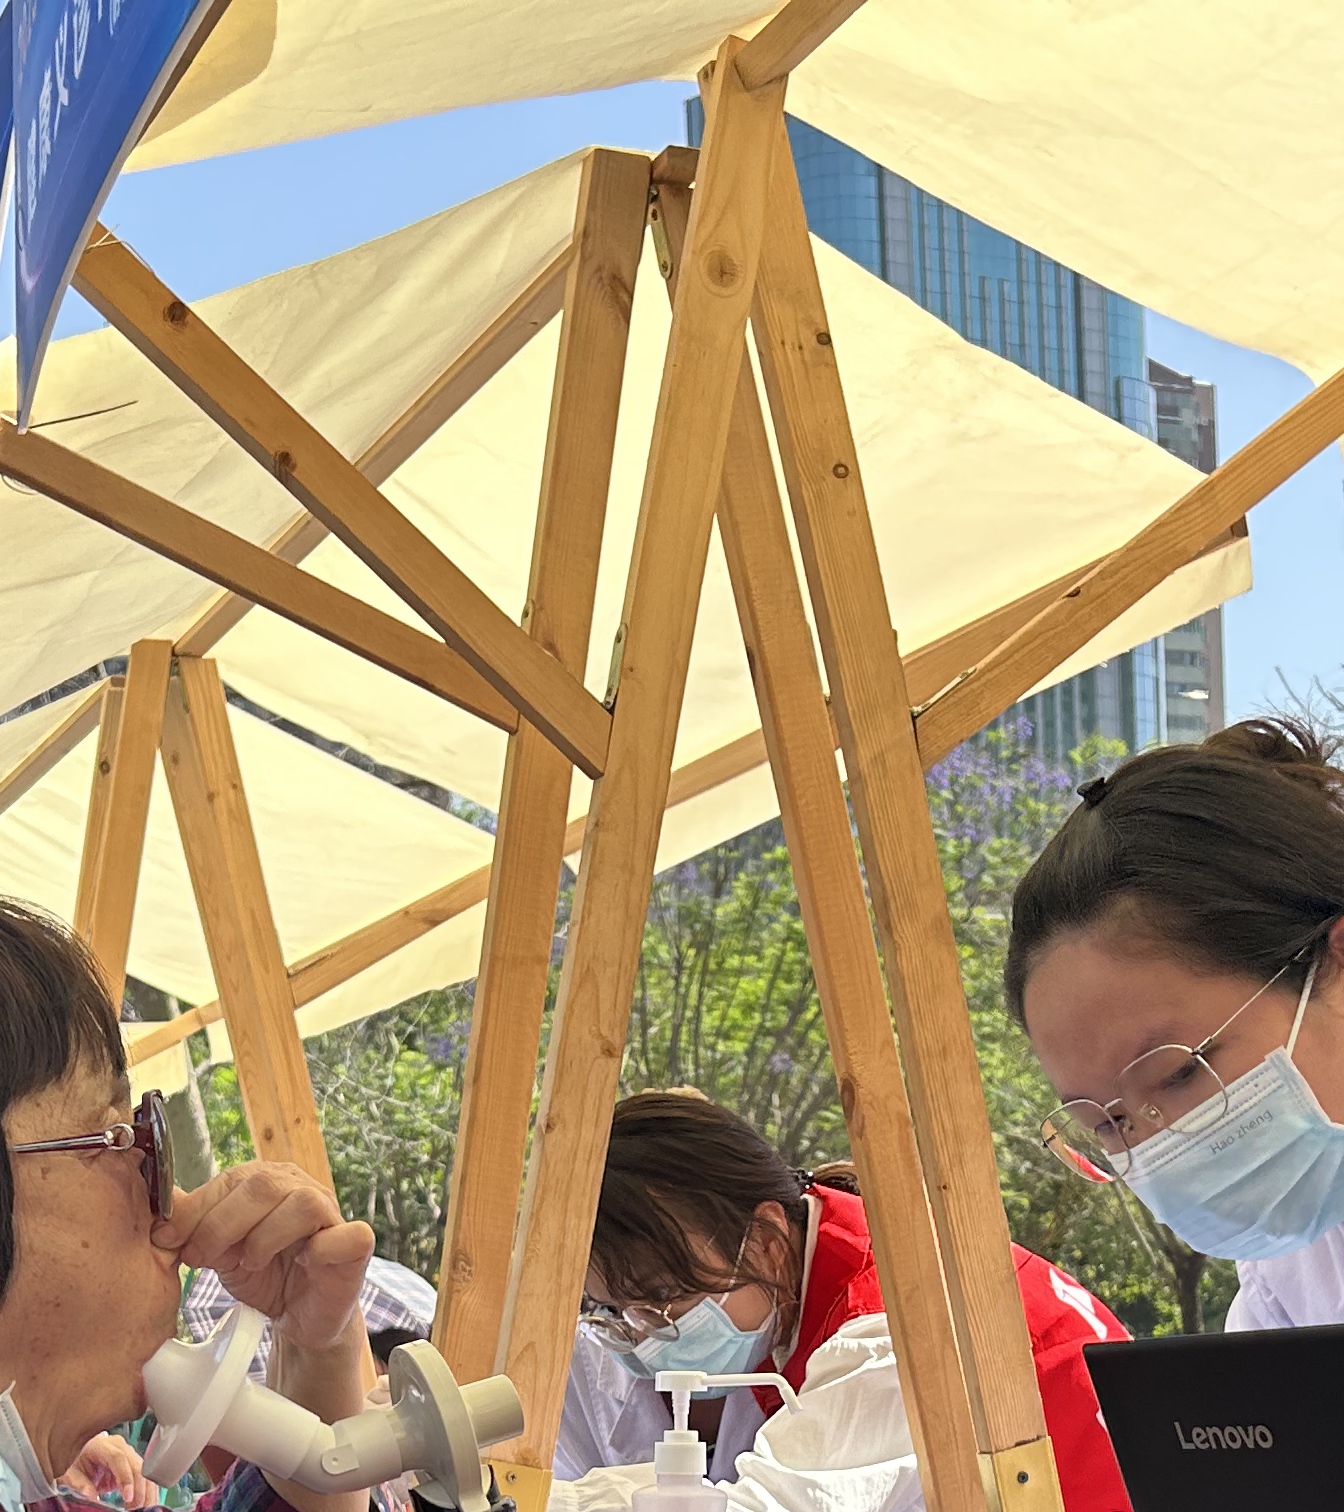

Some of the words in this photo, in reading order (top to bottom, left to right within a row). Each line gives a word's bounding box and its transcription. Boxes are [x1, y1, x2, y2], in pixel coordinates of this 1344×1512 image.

[1209, 1136, 1235, 1155] Hao
[1238, 1110, 1273, 1139] zheng
[1174, 1421, 1273, 1450] Lenovo
